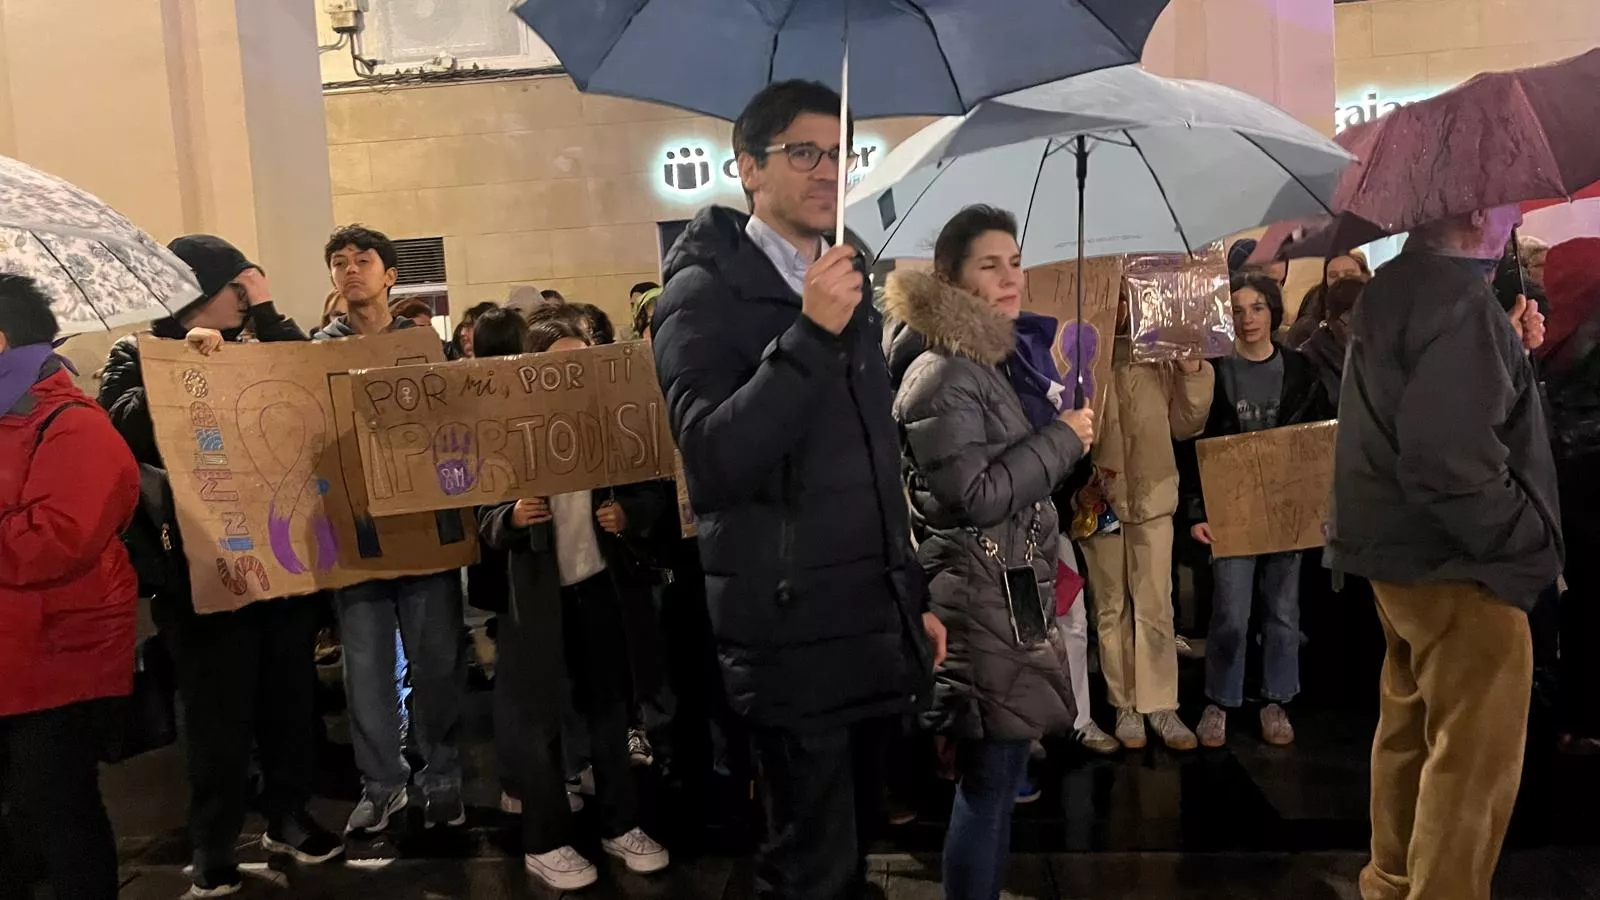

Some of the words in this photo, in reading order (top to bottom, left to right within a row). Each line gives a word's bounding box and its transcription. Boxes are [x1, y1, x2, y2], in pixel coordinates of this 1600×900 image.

[364, 373, 448, 416] POR
[517, 359, 584, 394] POR
[440, 467, 466, 490] 8M
